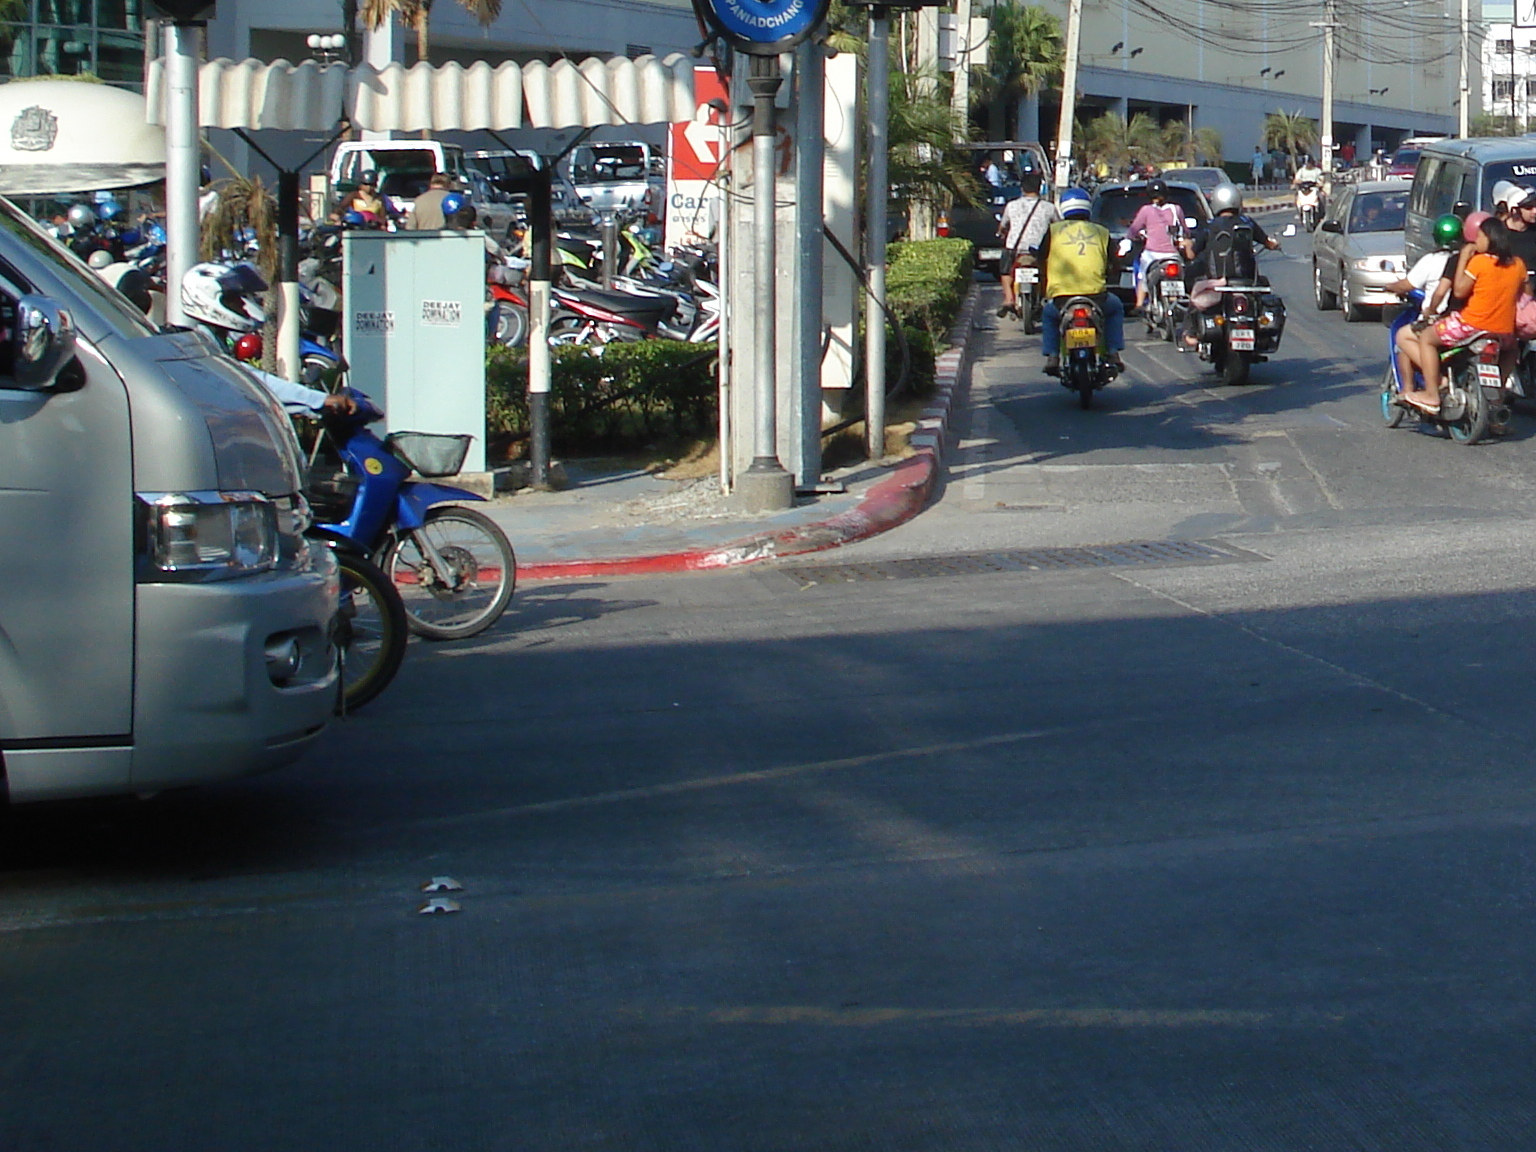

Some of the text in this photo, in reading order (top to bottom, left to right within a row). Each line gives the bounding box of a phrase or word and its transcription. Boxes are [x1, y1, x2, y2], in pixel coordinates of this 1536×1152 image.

[671, 193, 709, 210] Car
[1077, 242, 1086, 256] 2
[423, 301, 460, 309] DEEJAY
[356, 312, 394, 320] DEEJAY
